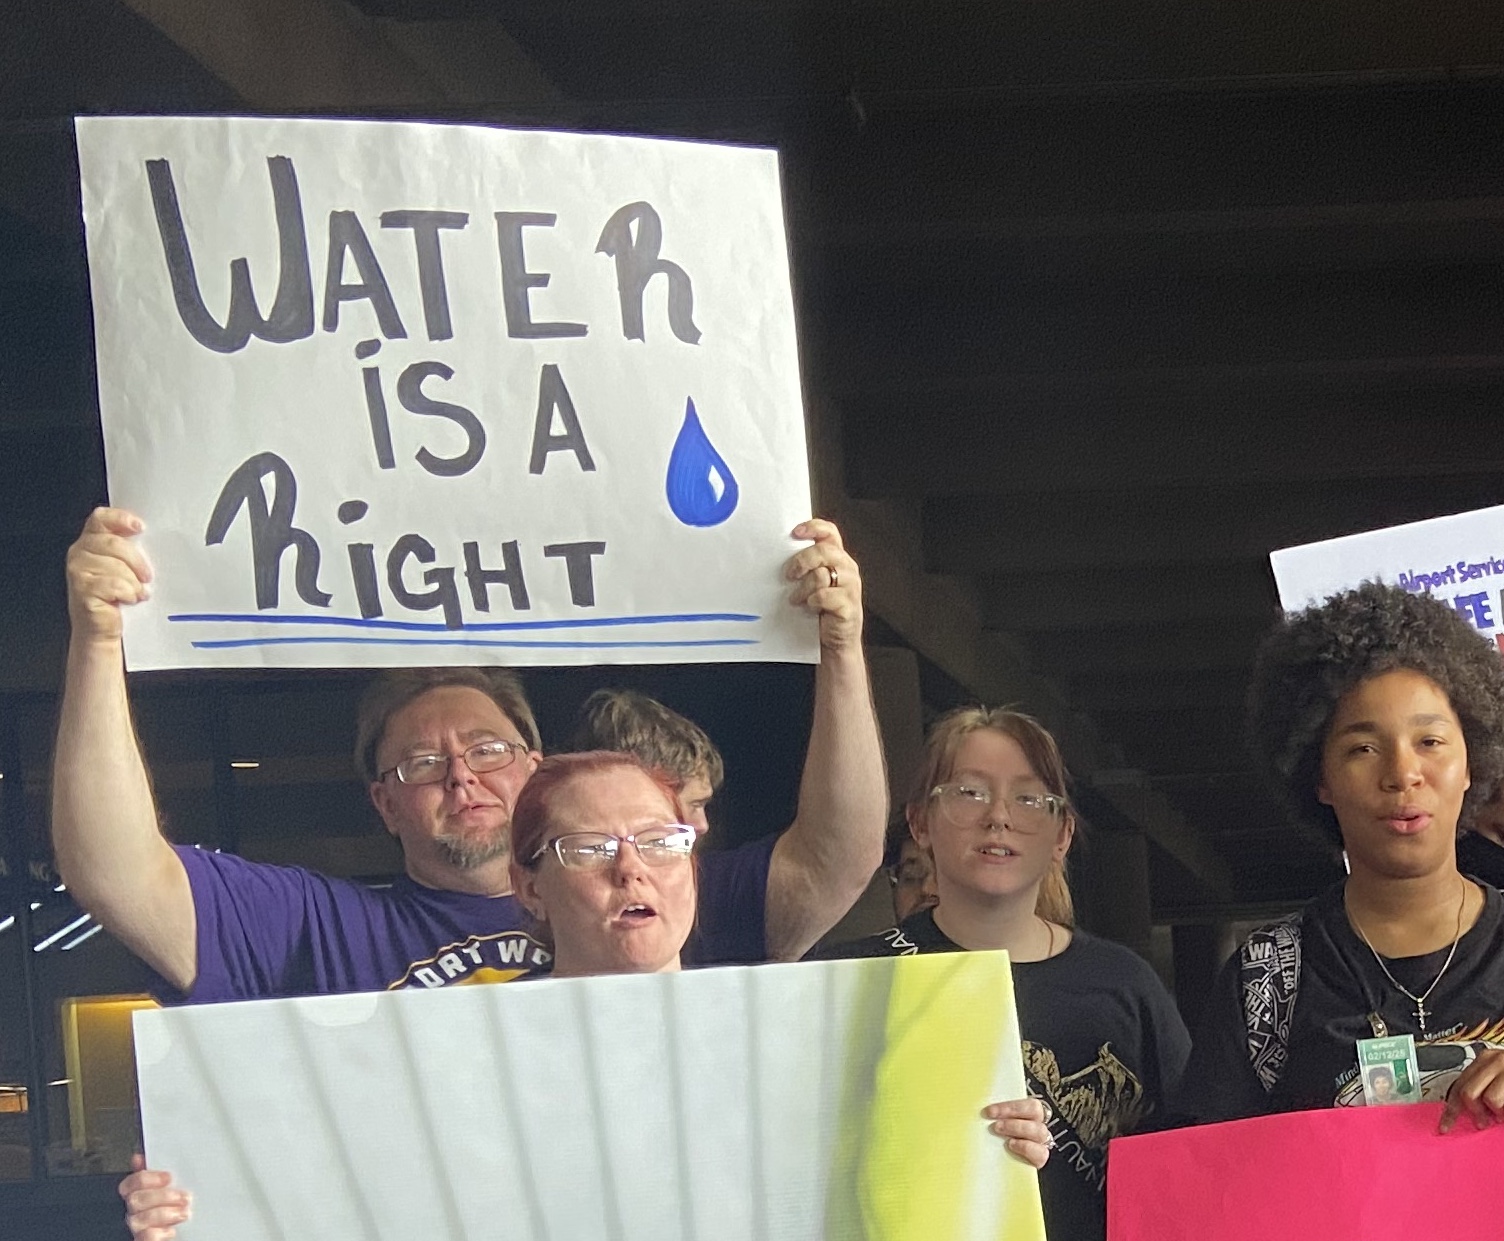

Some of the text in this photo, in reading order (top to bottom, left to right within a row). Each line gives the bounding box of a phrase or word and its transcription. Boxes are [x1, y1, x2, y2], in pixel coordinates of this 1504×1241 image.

[146, 155, 702, 353] WATER
[529, 363, 596, 474] A
[404, 941, 483, 989] ORT
